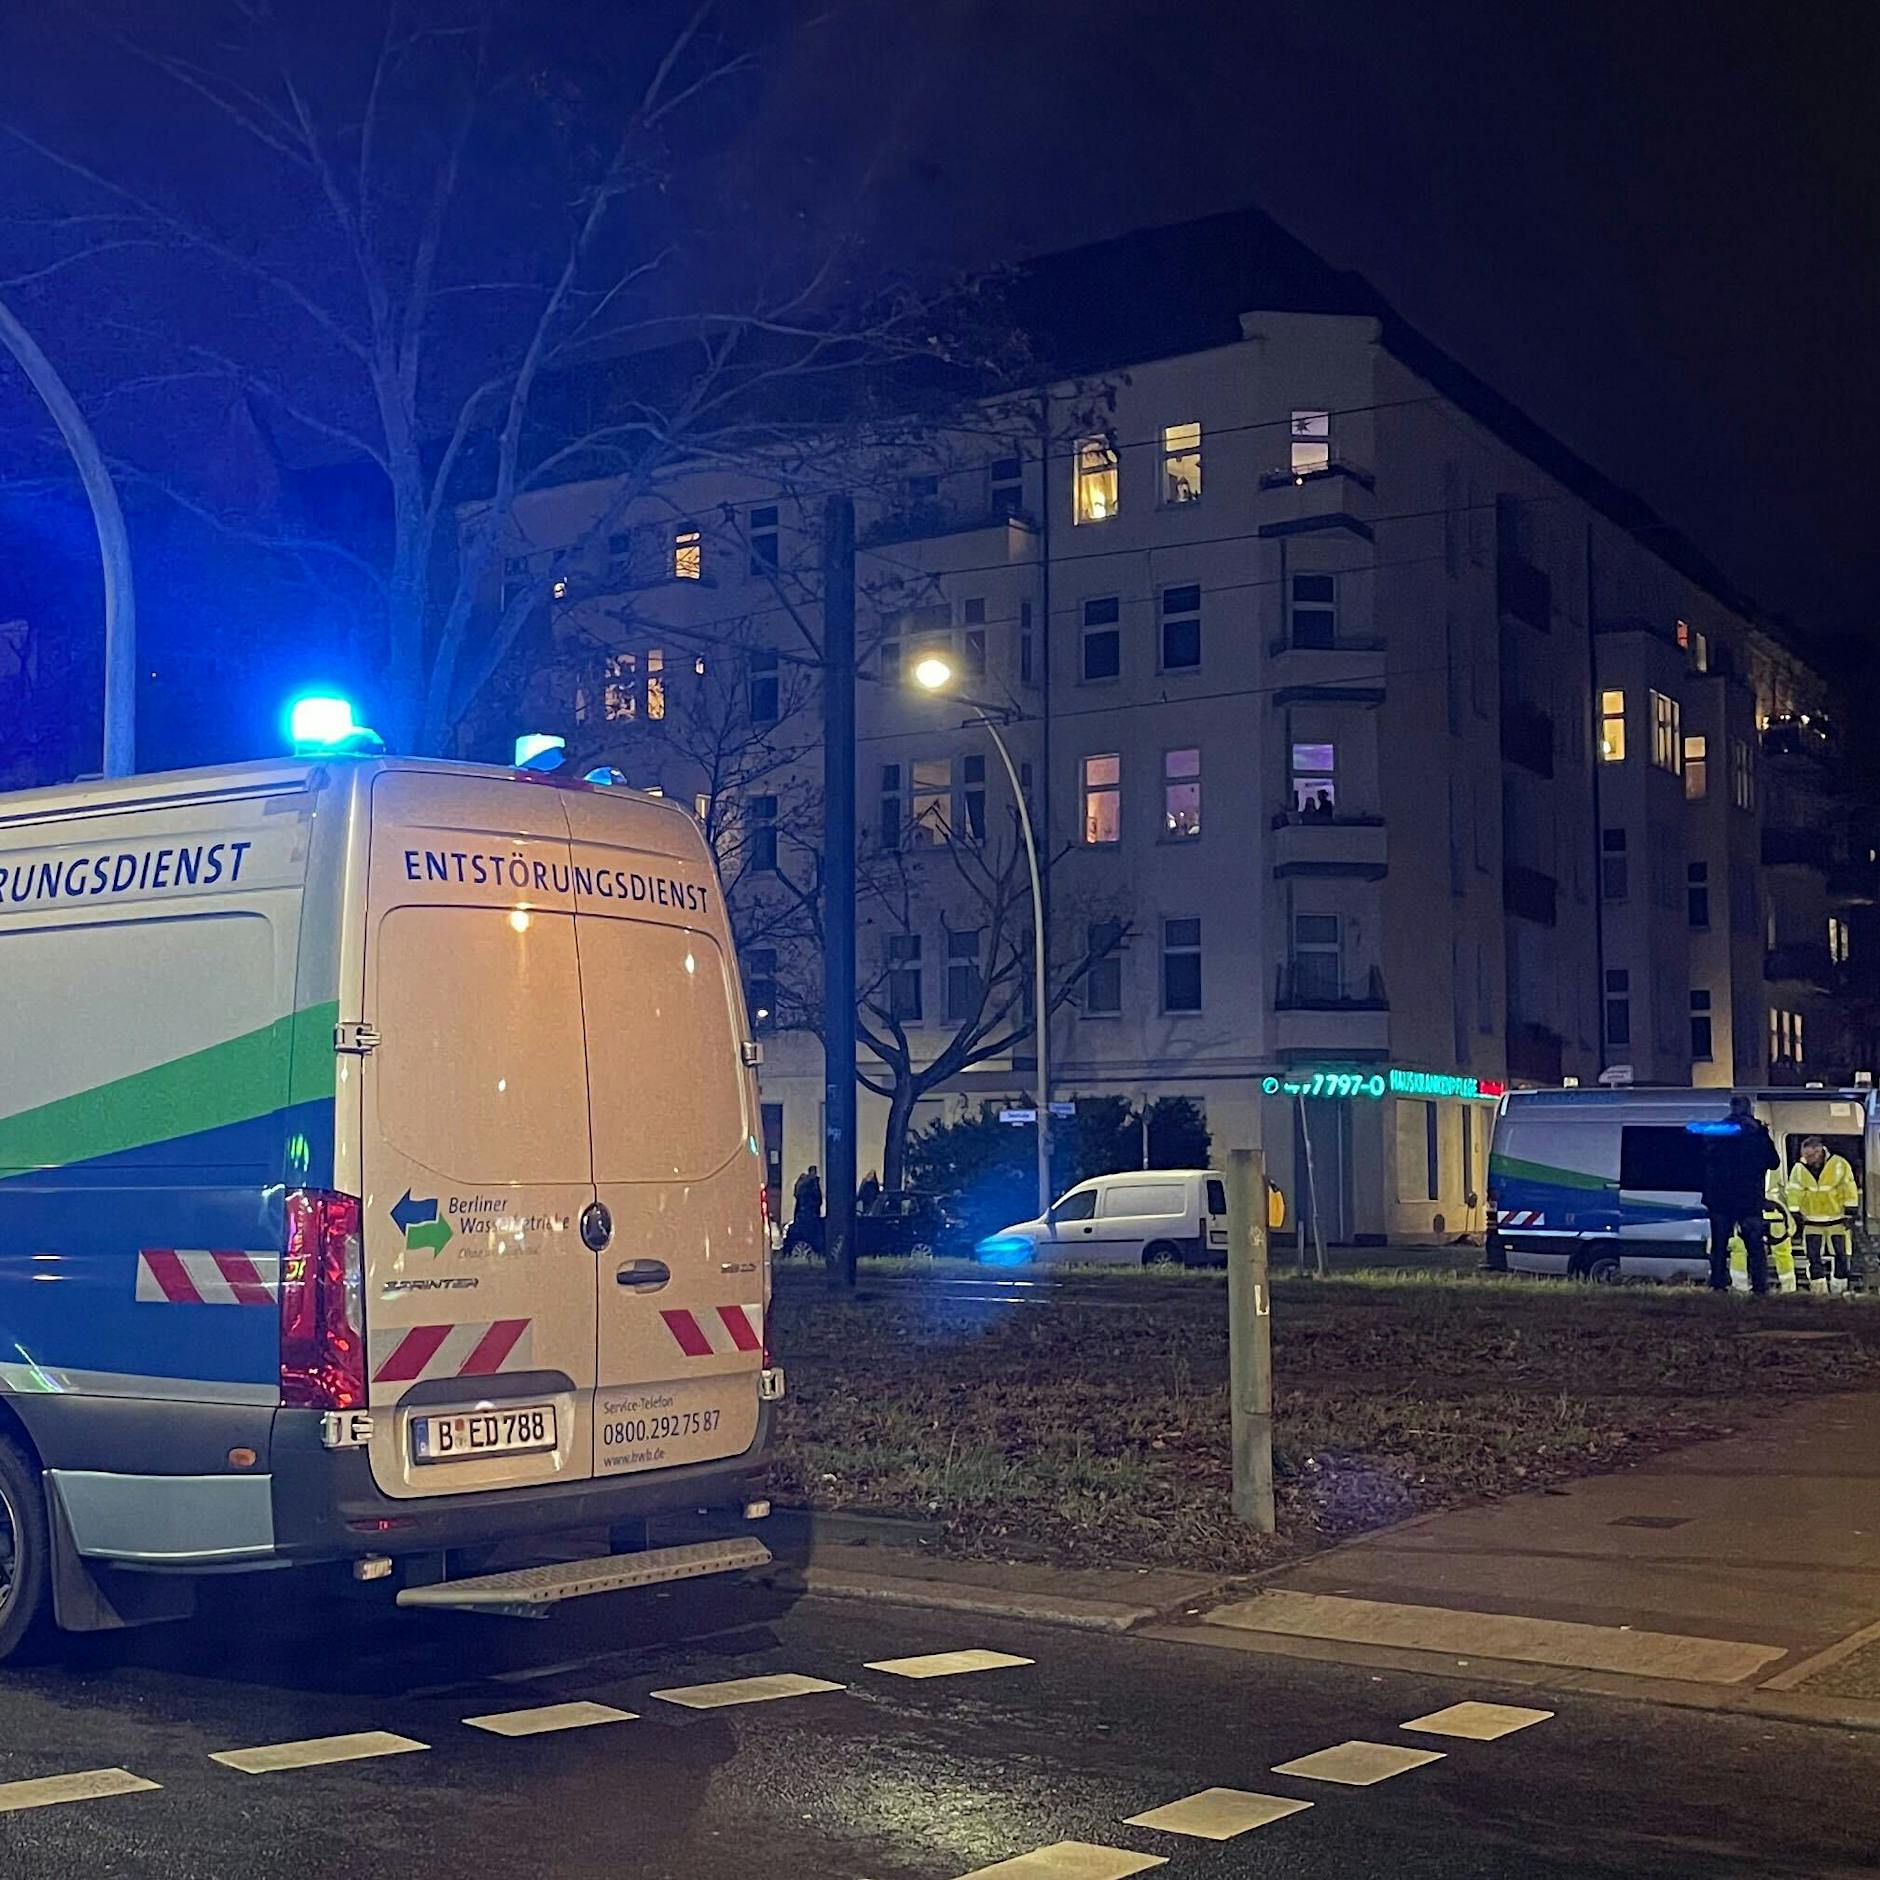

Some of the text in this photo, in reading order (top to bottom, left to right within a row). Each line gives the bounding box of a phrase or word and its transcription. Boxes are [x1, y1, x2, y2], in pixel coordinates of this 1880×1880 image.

[404, 850, 708, 913] ENTSTÖRUNGSDIENST
[448, 1195, 508, 1214] Berliner
[604, 1395, 674, 1414] Service-Telefon
[439, 1412, 544, 1451] B ED 788
